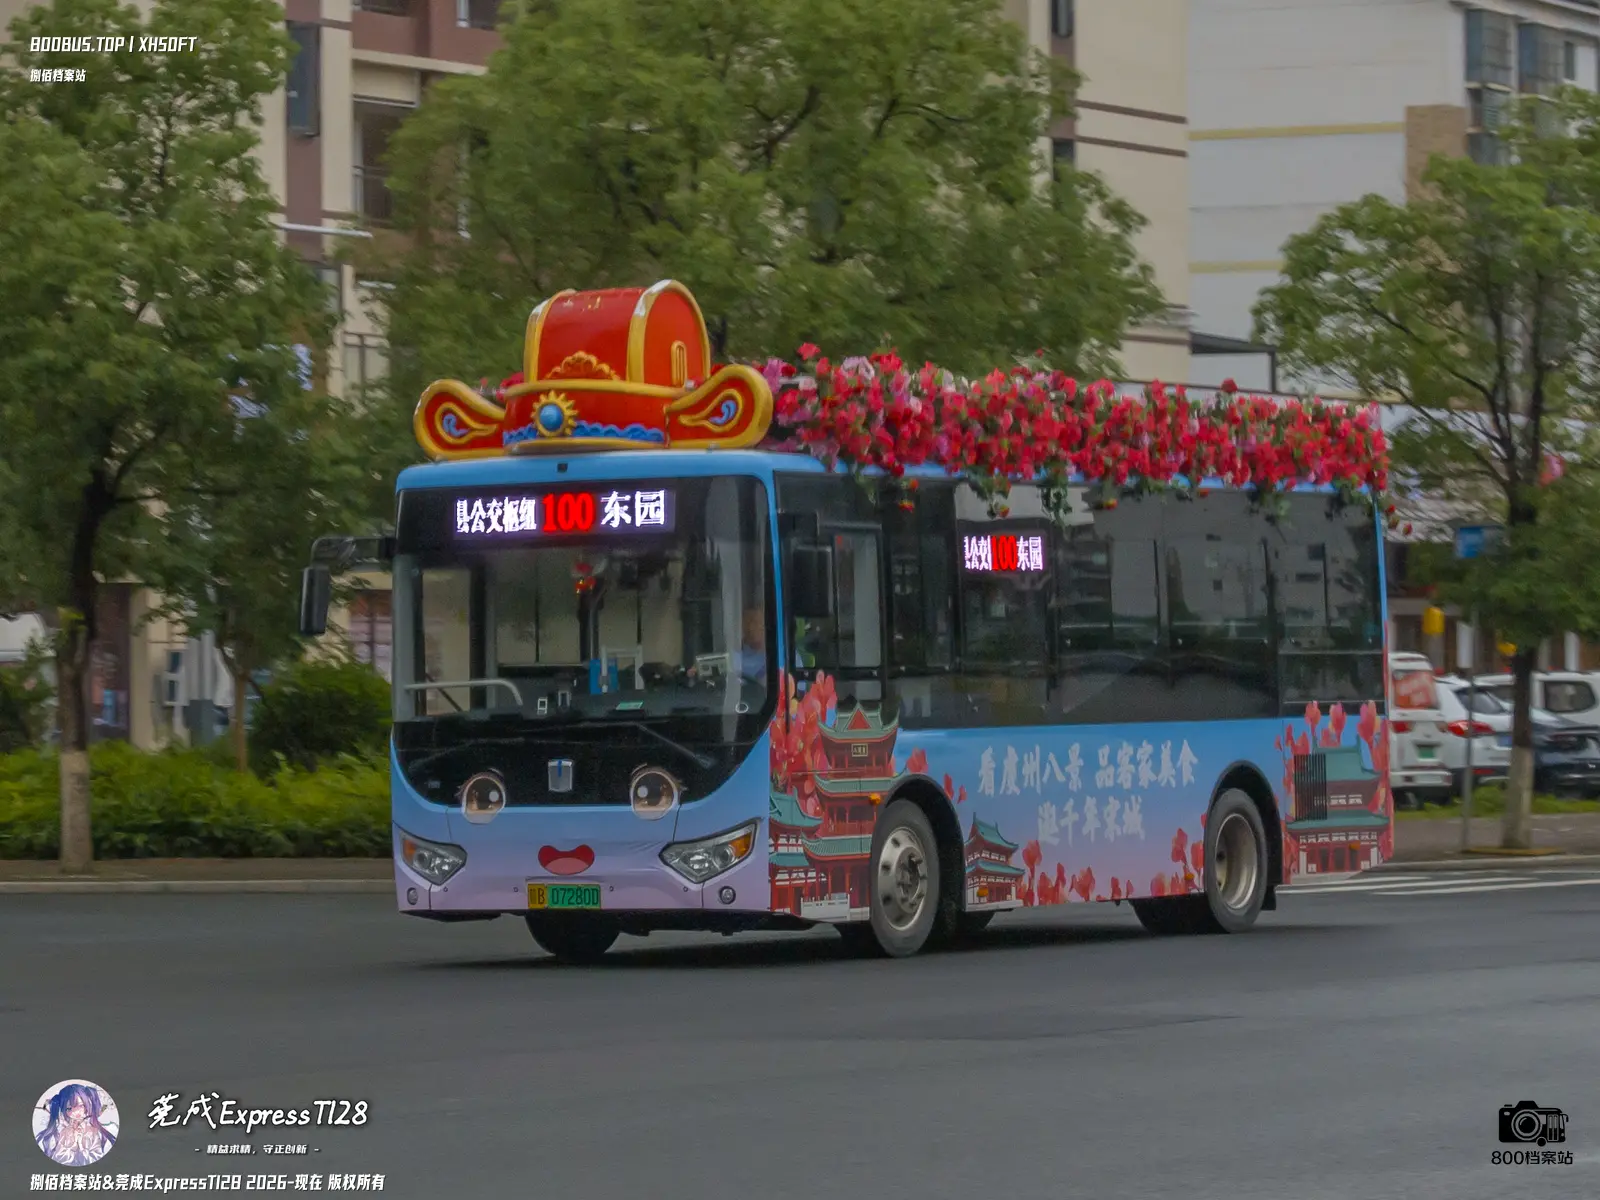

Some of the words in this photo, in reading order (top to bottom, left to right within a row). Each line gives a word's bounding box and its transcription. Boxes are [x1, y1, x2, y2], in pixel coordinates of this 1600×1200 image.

[542, 493, 594, 533] 100
[600, 489, 665, 527] 东园
[991, 535, 1018, 572] 100
[1016, 535, 1043, 571] 东园
